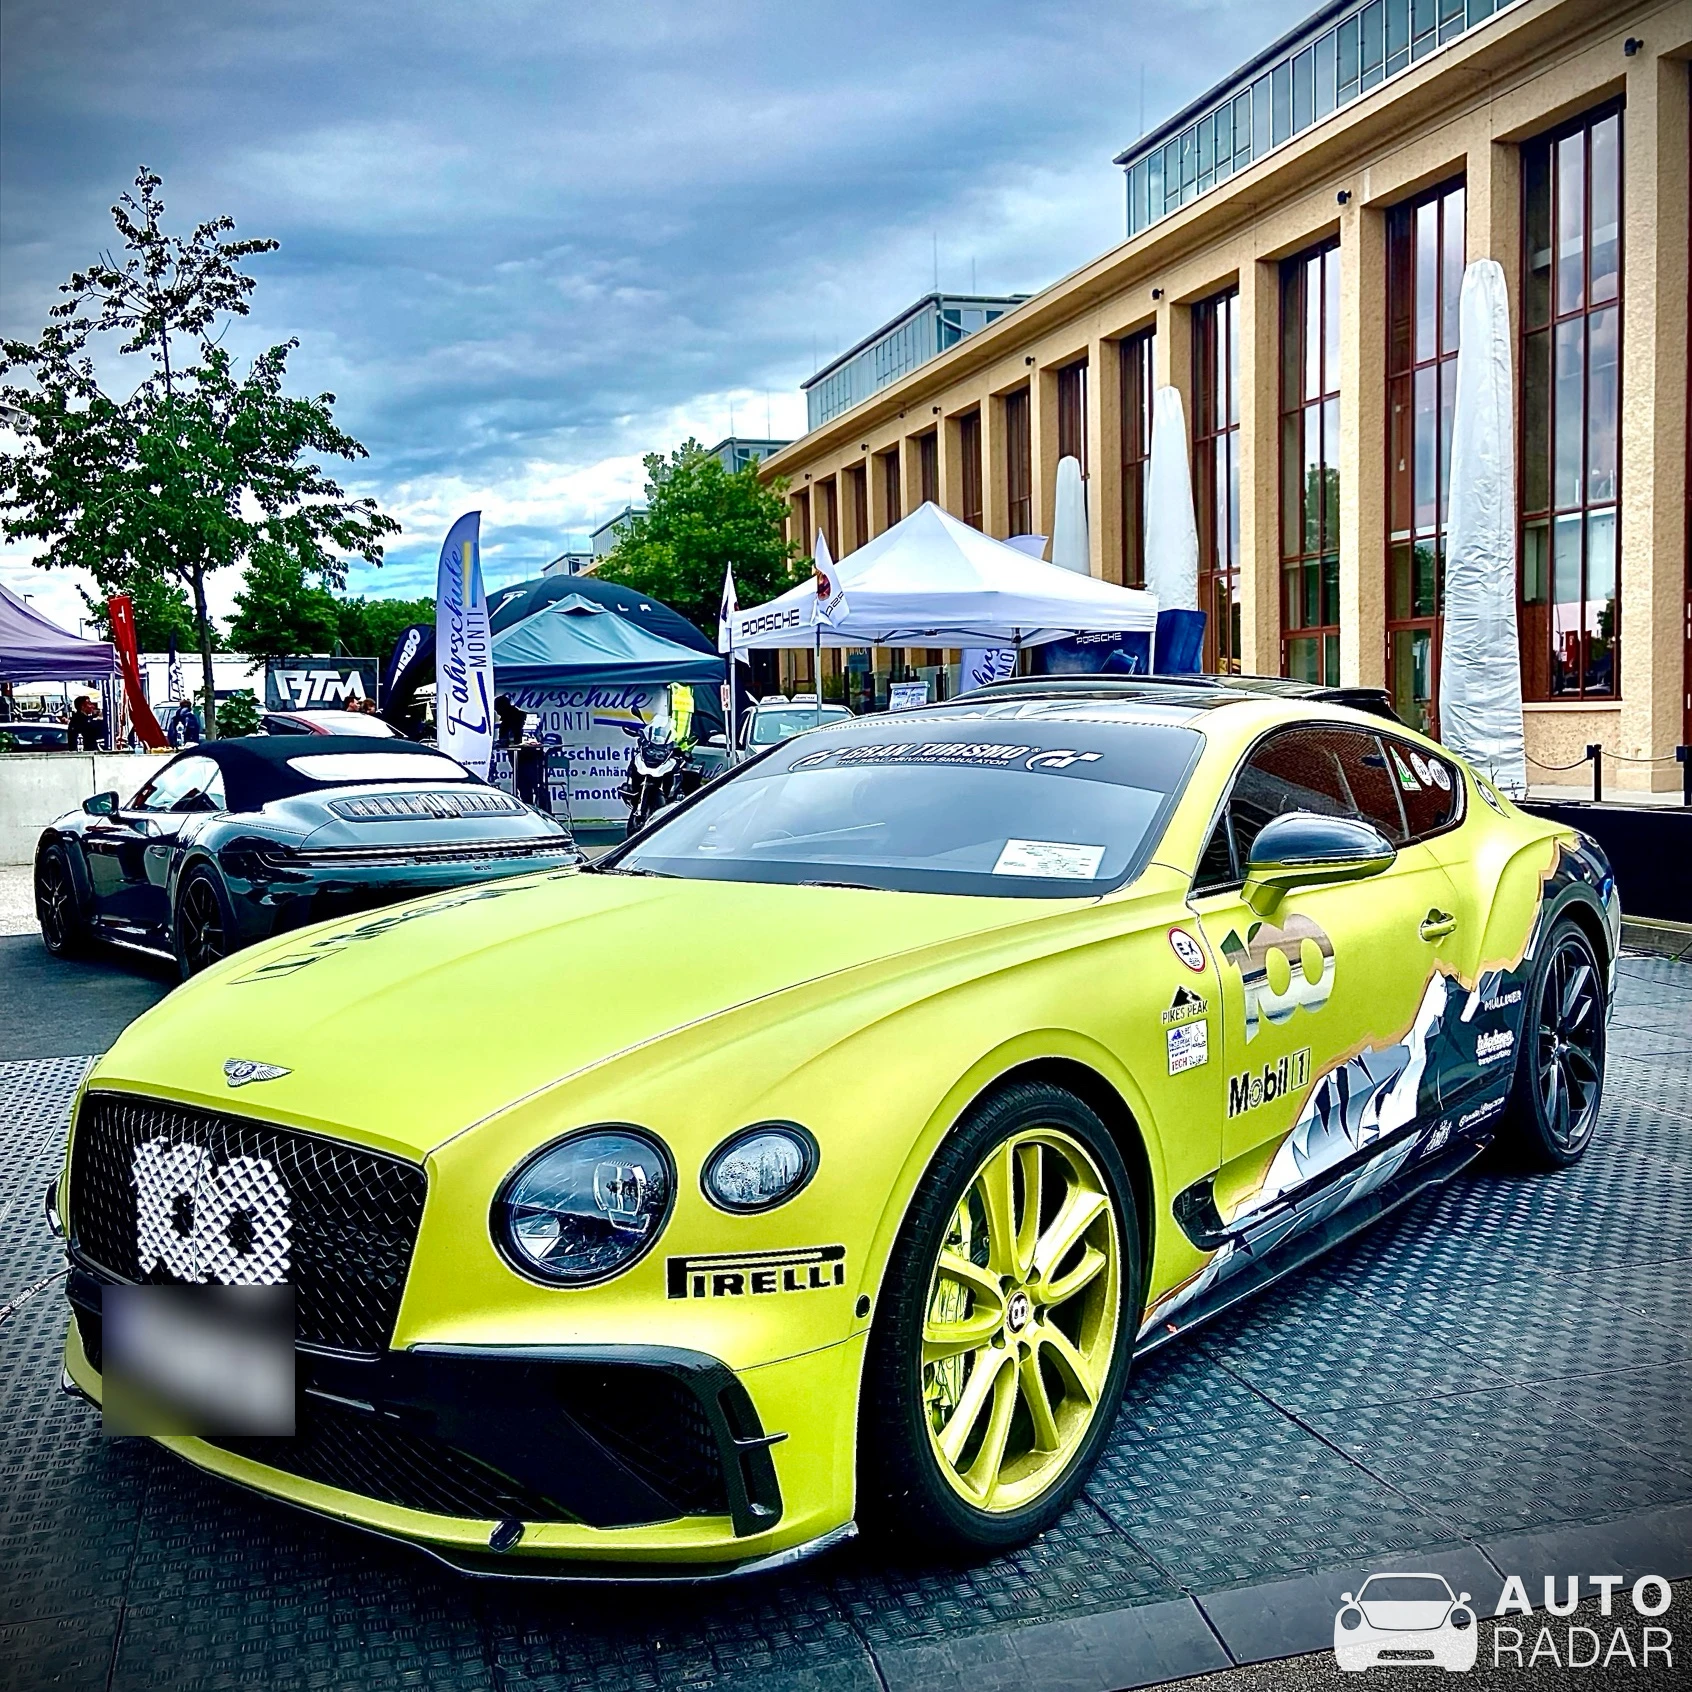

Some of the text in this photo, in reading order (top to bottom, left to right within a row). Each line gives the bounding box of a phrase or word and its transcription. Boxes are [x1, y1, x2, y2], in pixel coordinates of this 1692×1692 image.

[443, 543, 486, 736] Fahrschule
[467, 612, 487, 668] MONTI
[742, 609, 799, 637] PORSCHE
[1076, 633, 1122, 644] PORSCHE
[841, 744, 917, 760] GRAN
[908, 743, 1030, 760] TURISMO
[936, 757, 1009, 766] SIMULATOR
[1220, 914, 1336, 1045] 100
[1162, 1000, 1208, 1025] PIKES PEAK
[1228, 1058, 1289, 1118] Mobil
[132, 1136, 292, 1286] 100
[667, 1245, 845, 1299] PIRELLI
